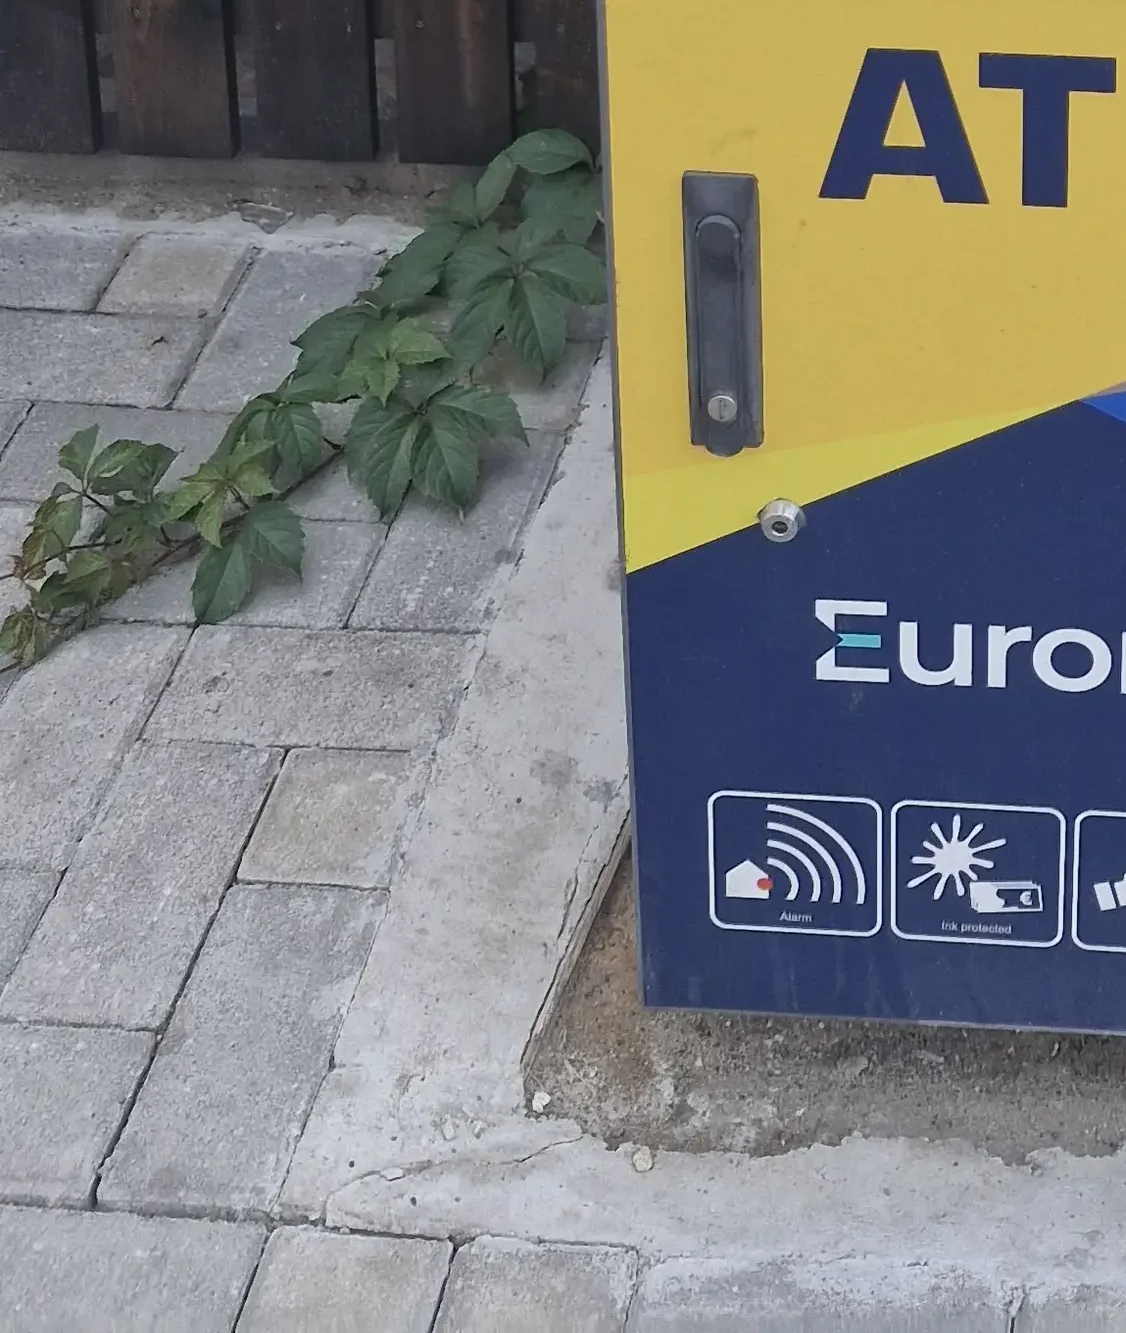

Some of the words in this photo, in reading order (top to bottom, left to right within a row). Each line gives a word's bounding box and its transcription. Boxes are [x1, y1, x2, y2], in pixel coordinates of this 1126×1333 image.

[780, 910, 812, 923] Alarm
[941, 920, 959, 932] Ink
[961, 921, 1012, 935] protected
